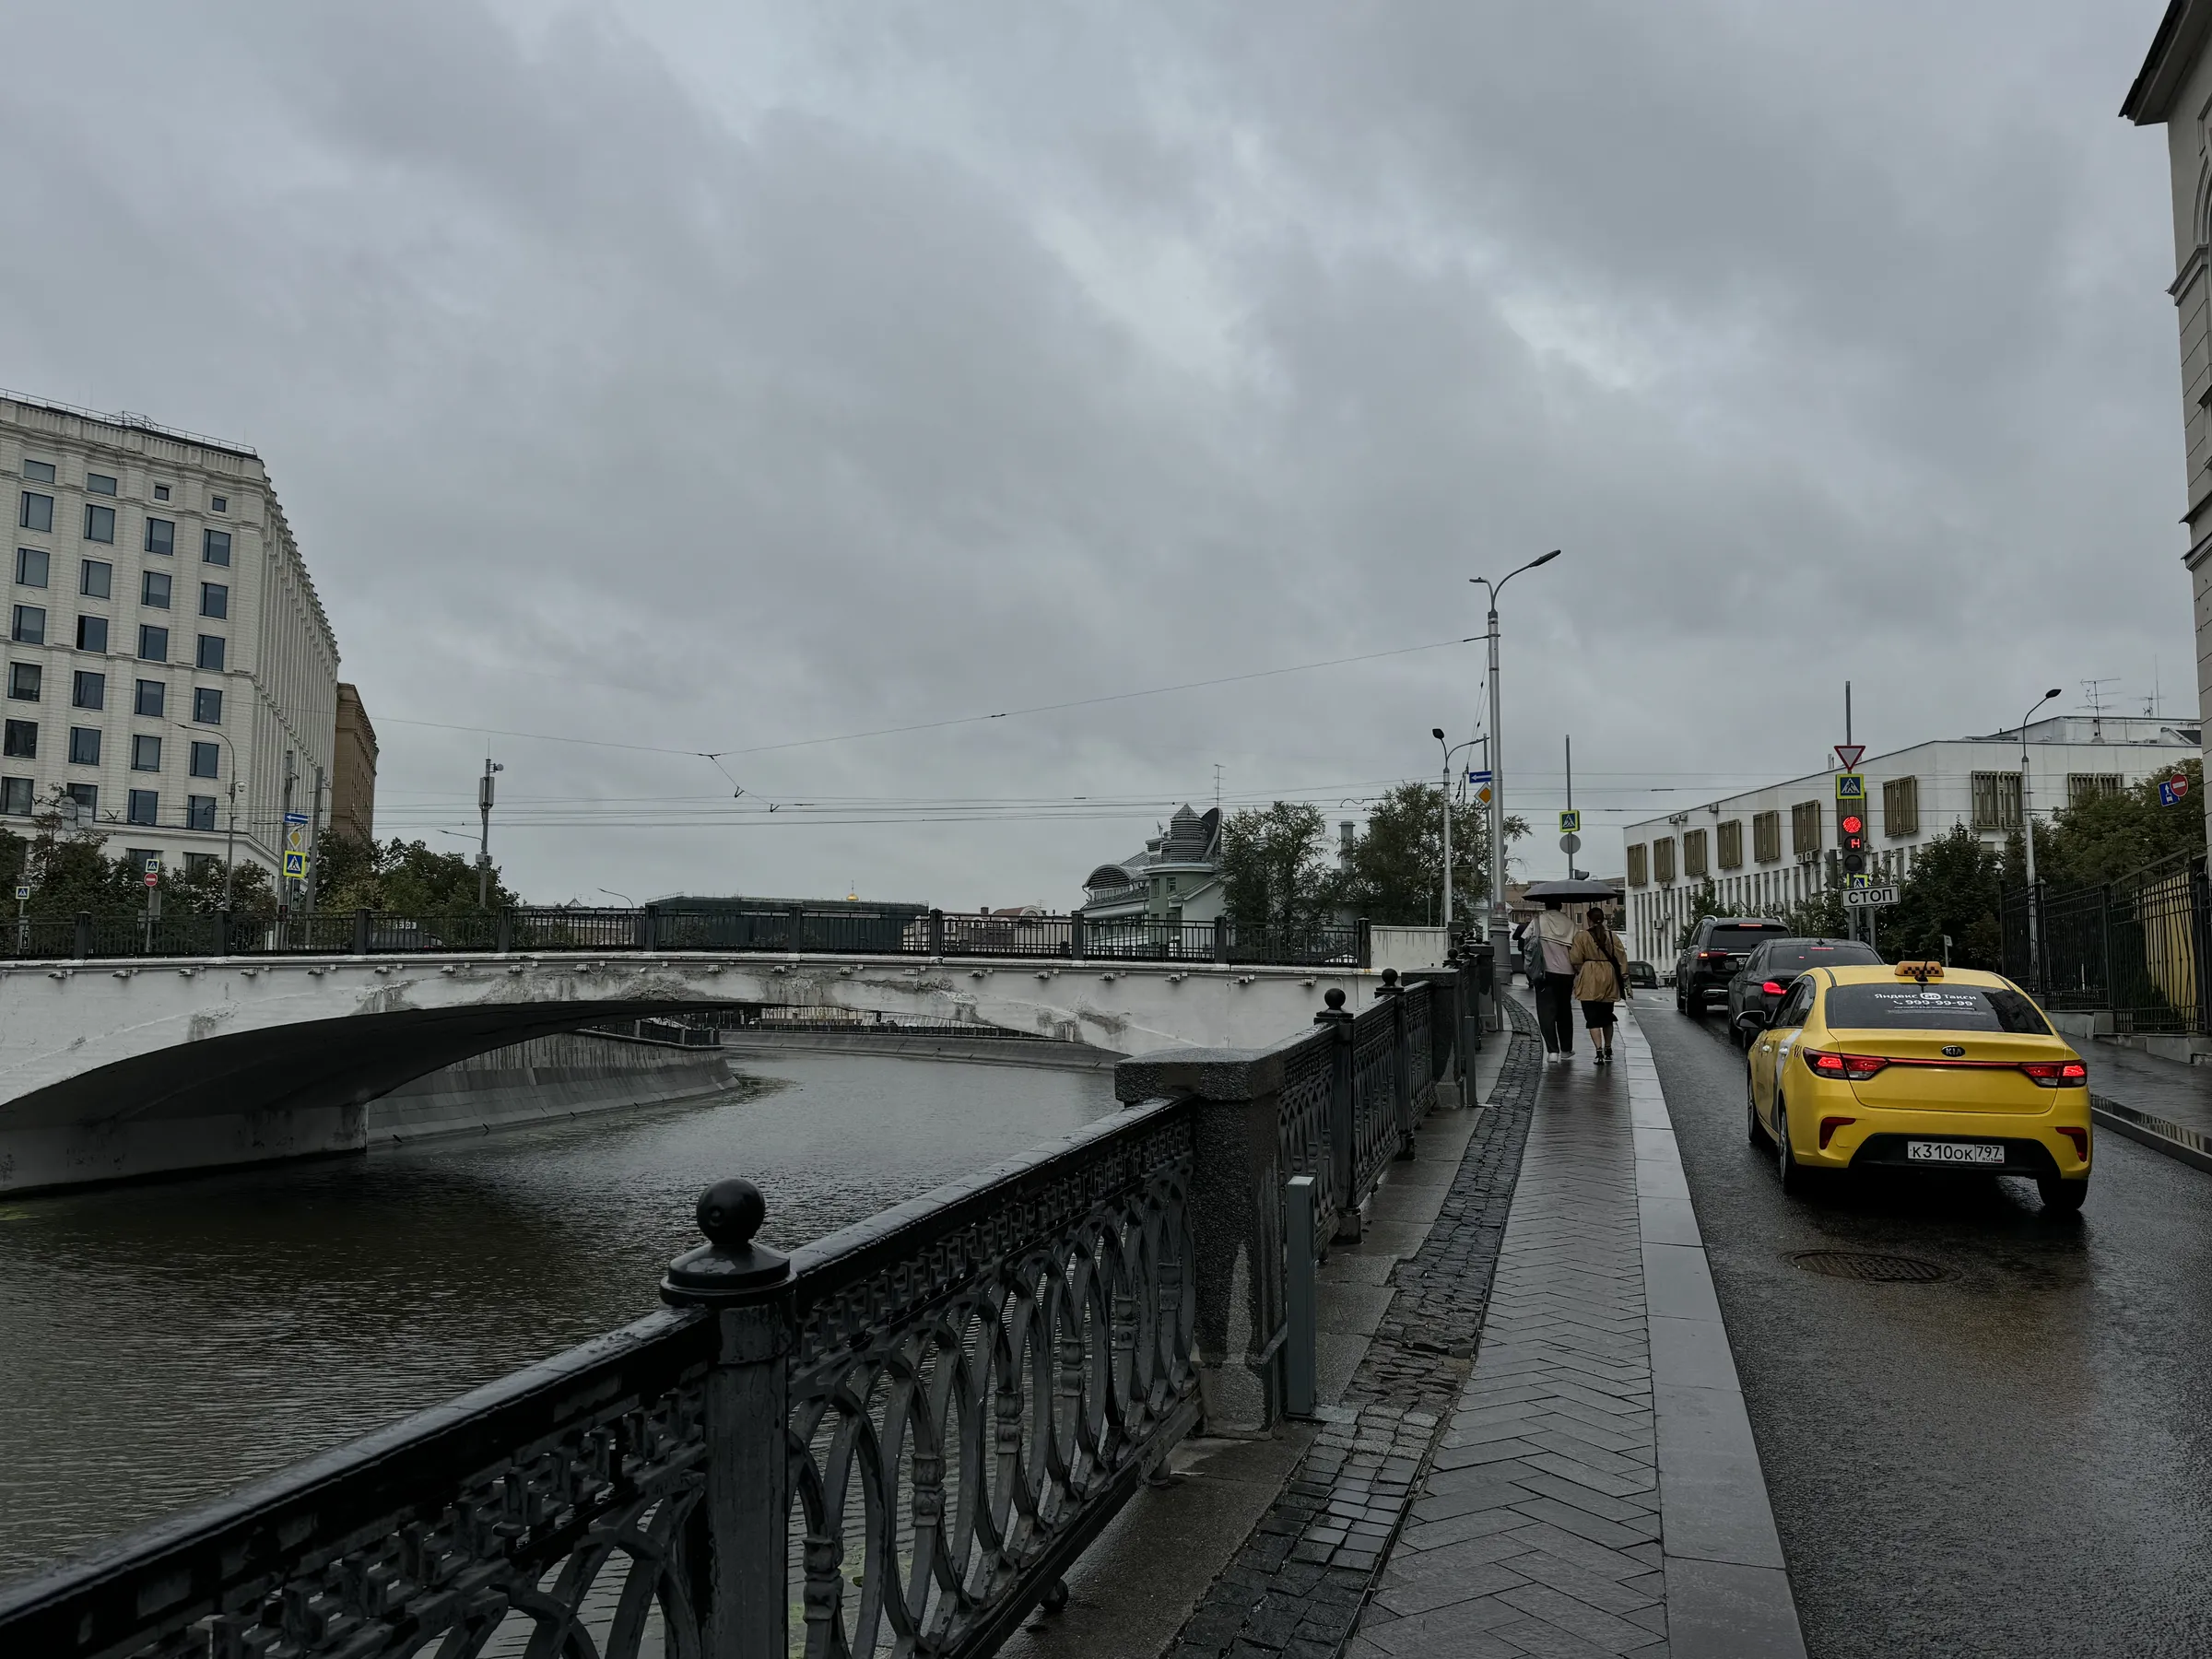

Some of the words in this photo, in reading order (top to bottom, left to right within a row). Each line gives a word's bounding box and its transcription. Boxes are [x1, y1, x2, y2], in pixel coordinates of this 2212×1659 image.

[1848, 888, 1892, 903] СТОП
[1946, 1047, 1962, 1055] KIA
[1976, 1146, 2000, 1159] 797
